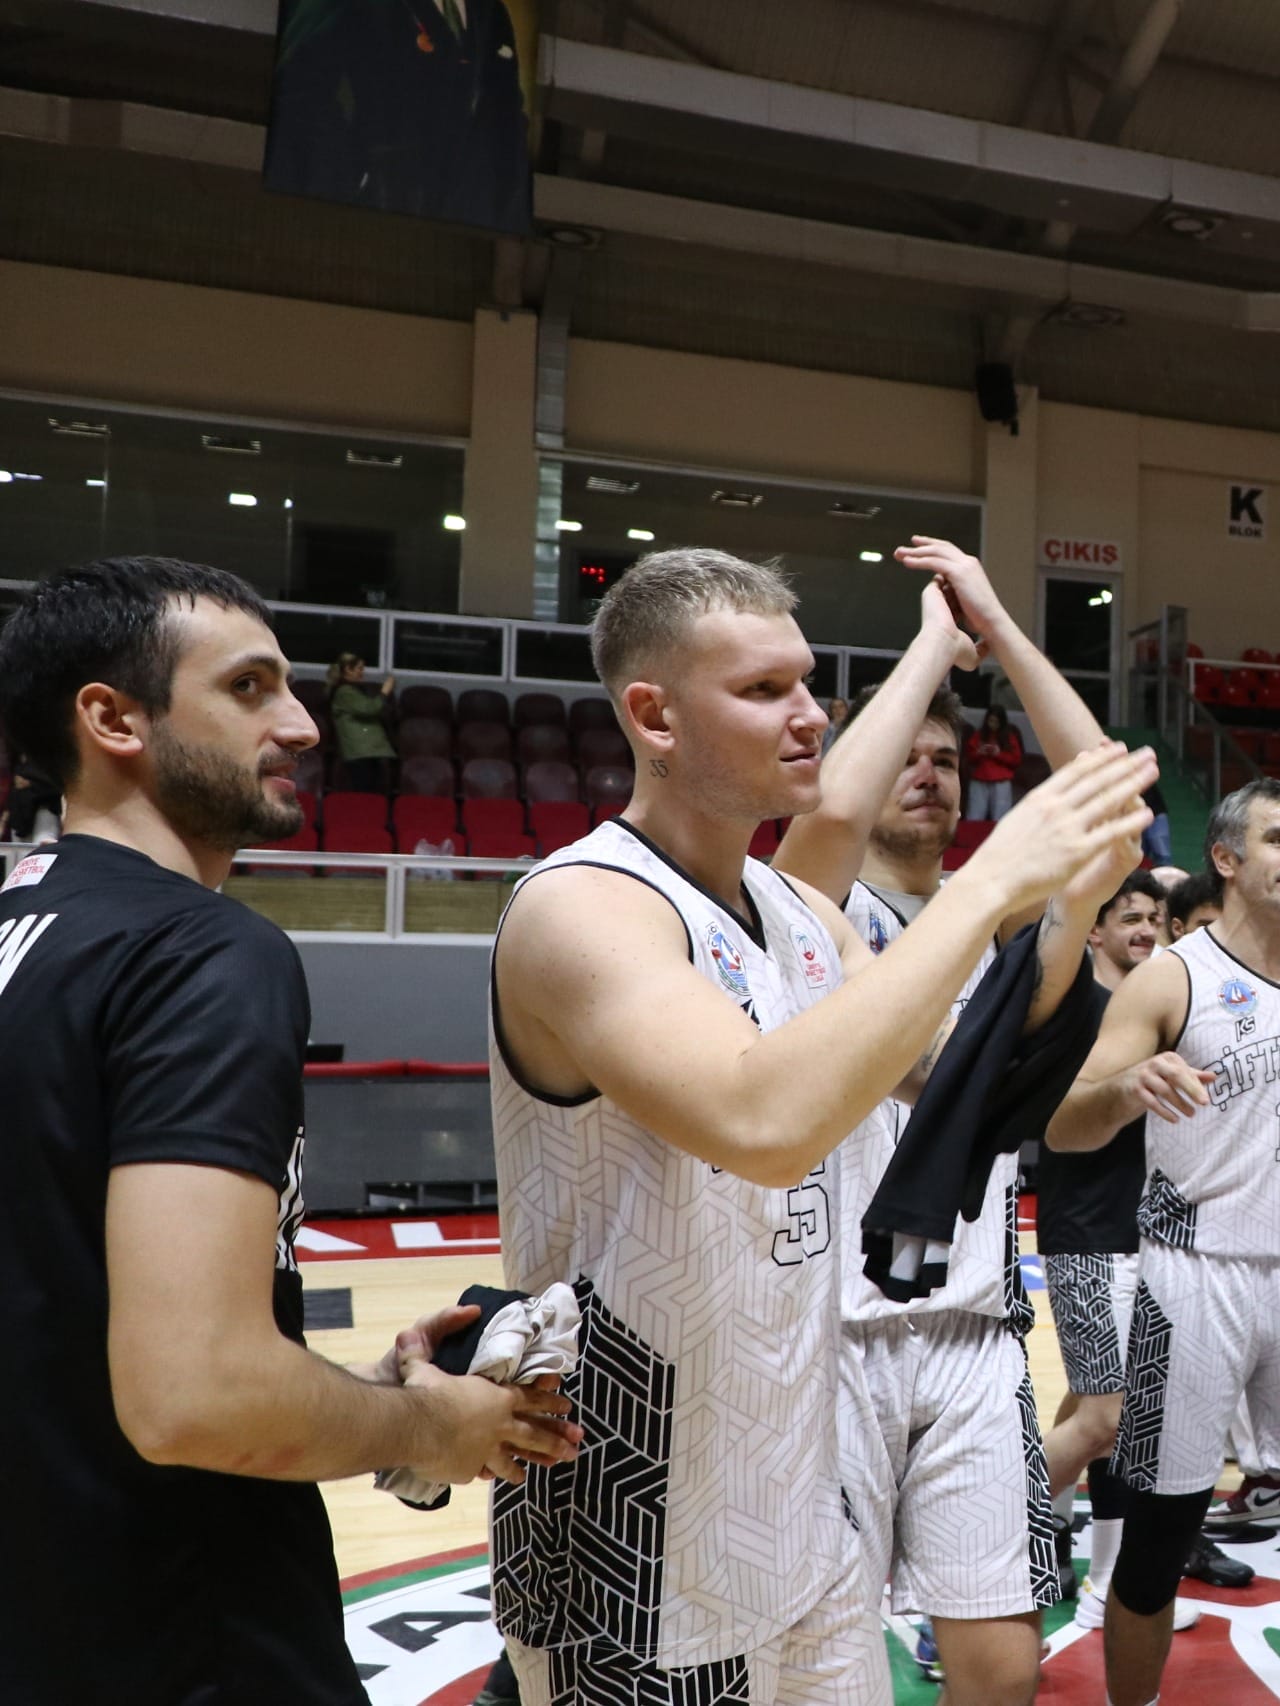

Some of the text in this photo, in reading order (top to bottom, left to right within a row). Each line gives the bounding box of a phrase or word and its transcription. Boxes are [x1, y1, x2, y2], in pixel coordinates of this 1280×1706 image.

[1230, 486, 1264, 524] K
[1228, 525, 1264, 538] BLOK
[1044, 538, 1119, 565] ÇIKIŞ
[1235, 1016, 1256, 1043] KS
